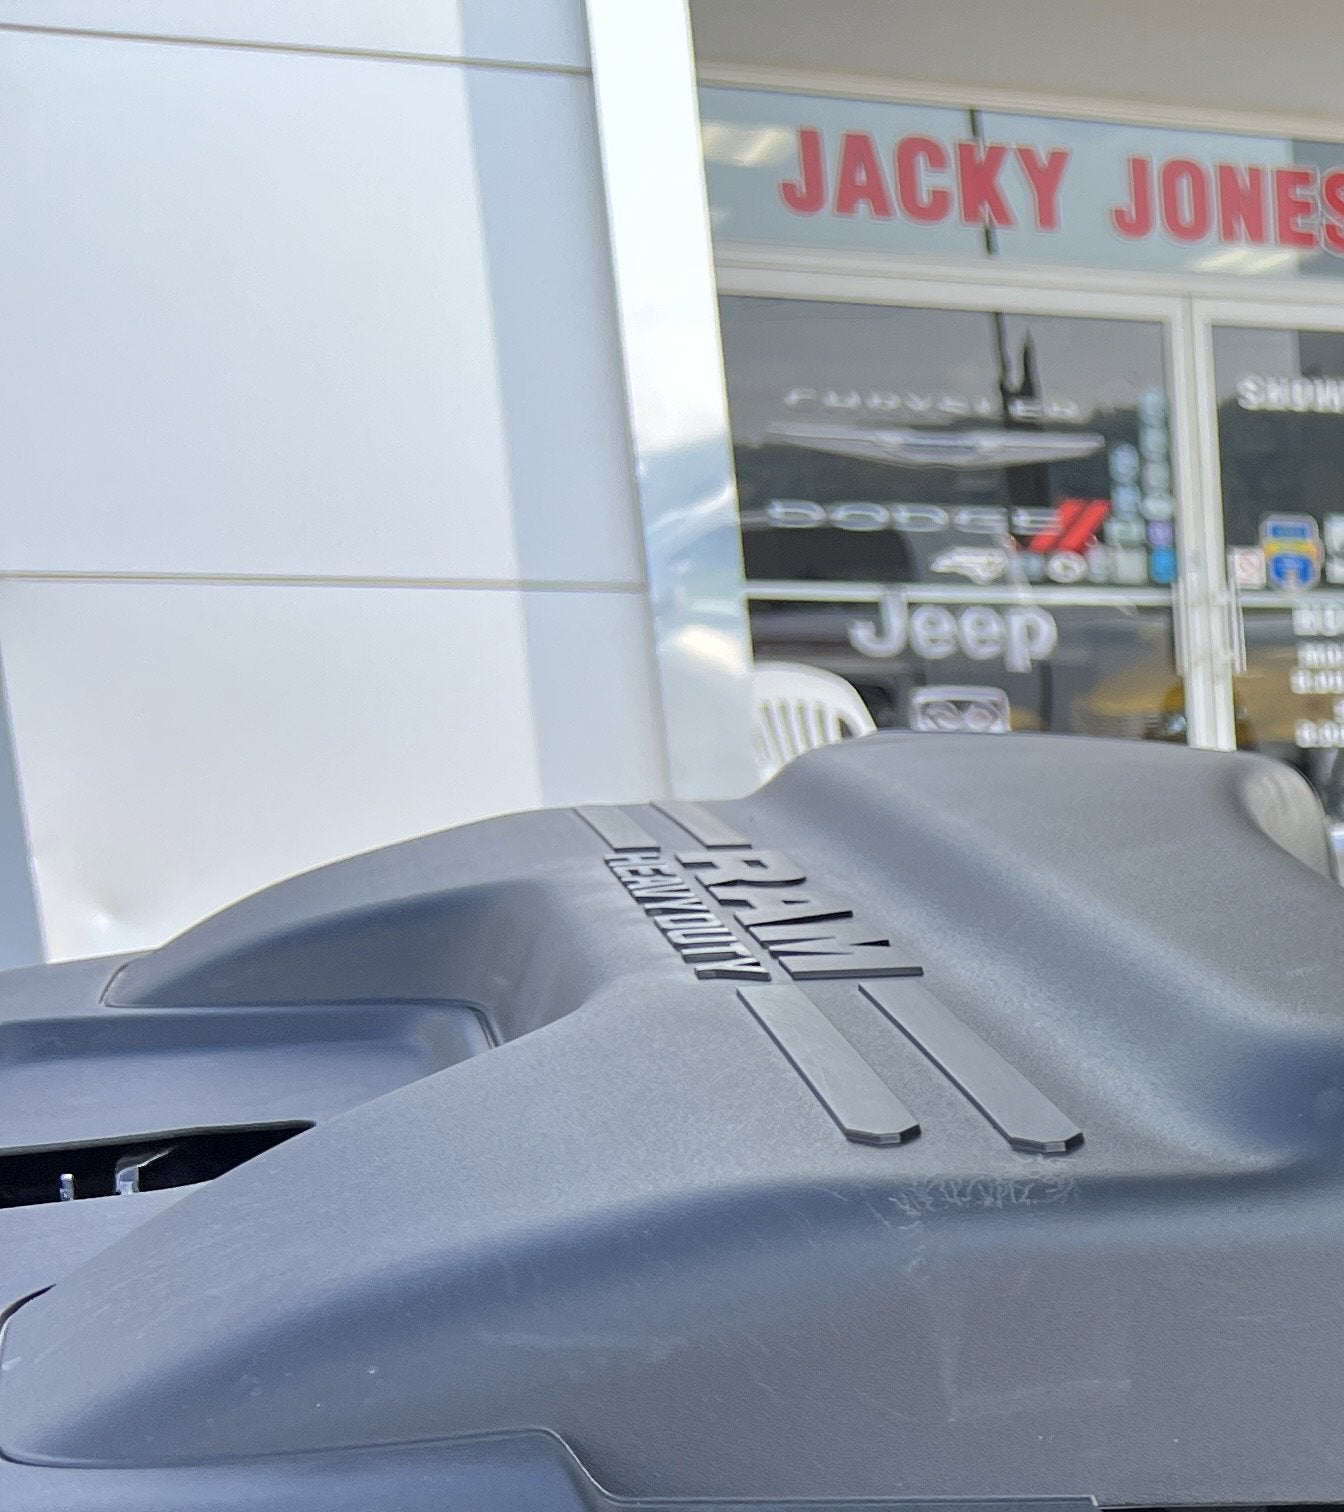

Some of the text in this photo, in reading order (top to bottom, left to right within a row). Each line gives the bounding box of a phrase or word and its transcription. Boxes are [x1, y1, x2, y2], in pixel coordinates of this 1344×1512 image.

[778, 126, 1072, 232] JACKY
[767, 498, 1062, 535] DODGE
[849, 588, 1058, 673] Jeep
[604, 852, 772, 981] HEAVY DUTY
[676, 849, 923, 979] RAM
